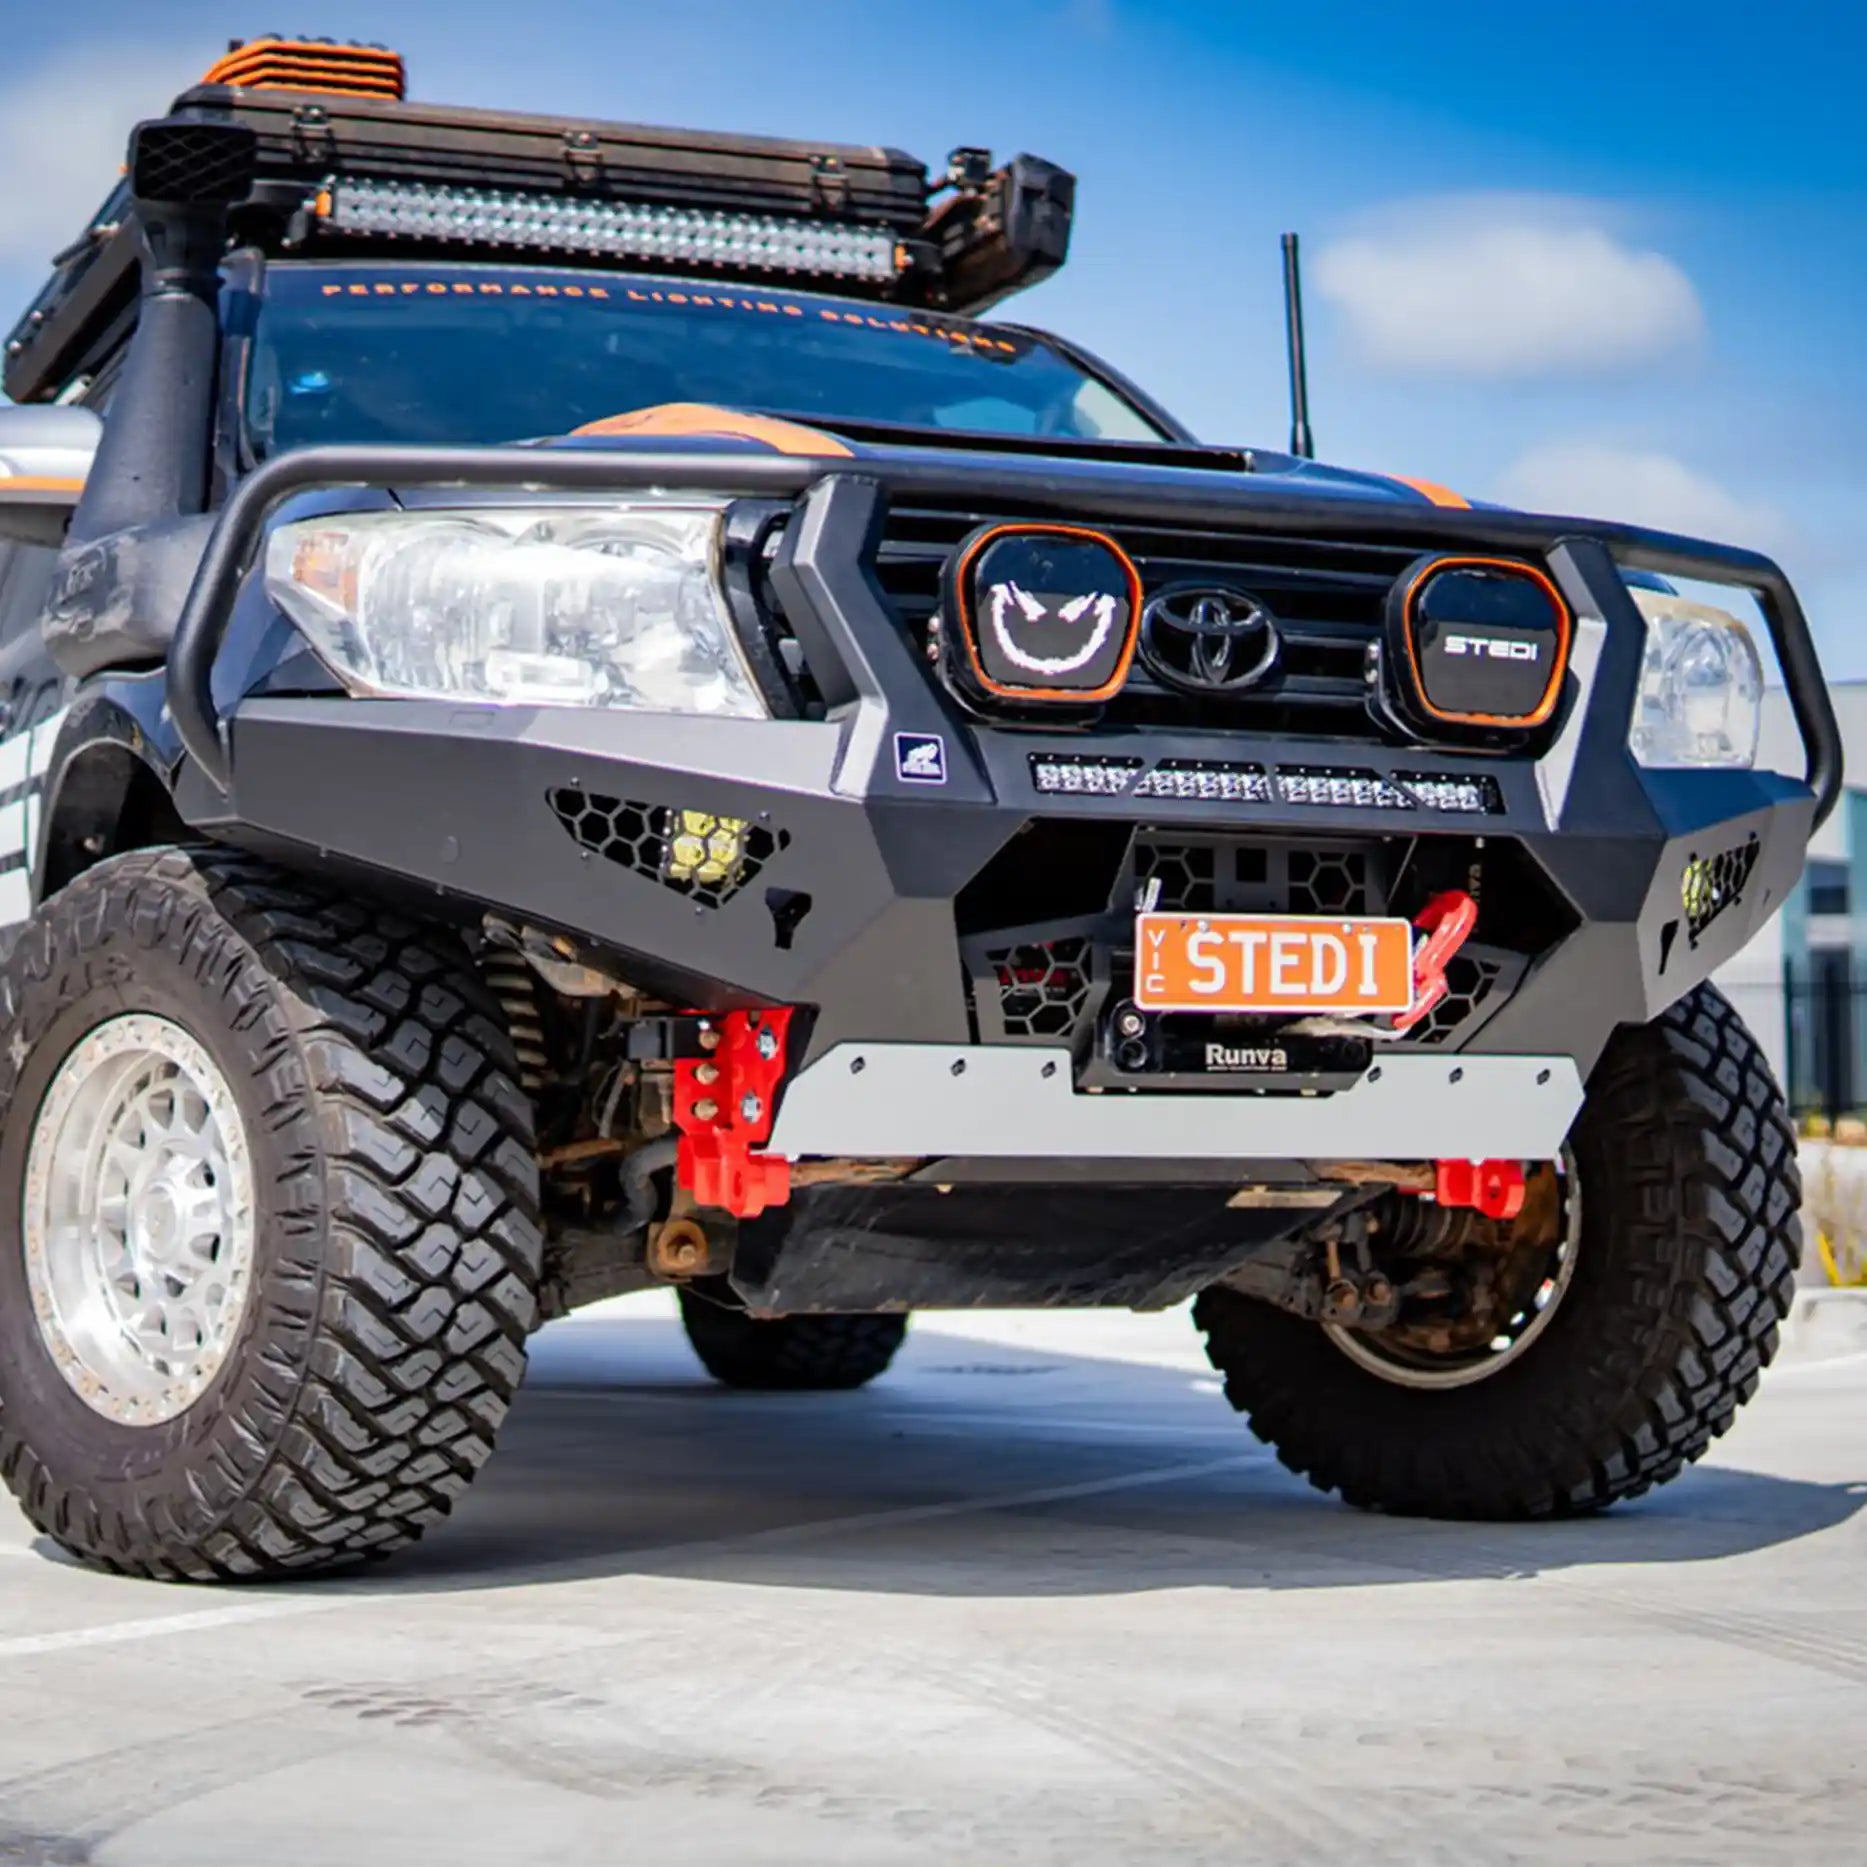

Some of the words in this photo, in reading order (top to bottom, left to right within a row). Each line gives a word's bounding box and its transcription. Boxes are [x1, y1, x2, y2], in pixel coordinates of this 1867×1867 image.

[322, 283, 610, 300] PERFORMANCE
[627, 289, 803, 317] LIGHTING
[819, 309, 1016, 353] SOLUTIONS
[1444, 635, 1538, 661] STEDI
[1145, 929, 1166, 993] VIC
[1186, 930, 1379, 996] STEDI
[1205, 1043, 1287, 1065] Runva
